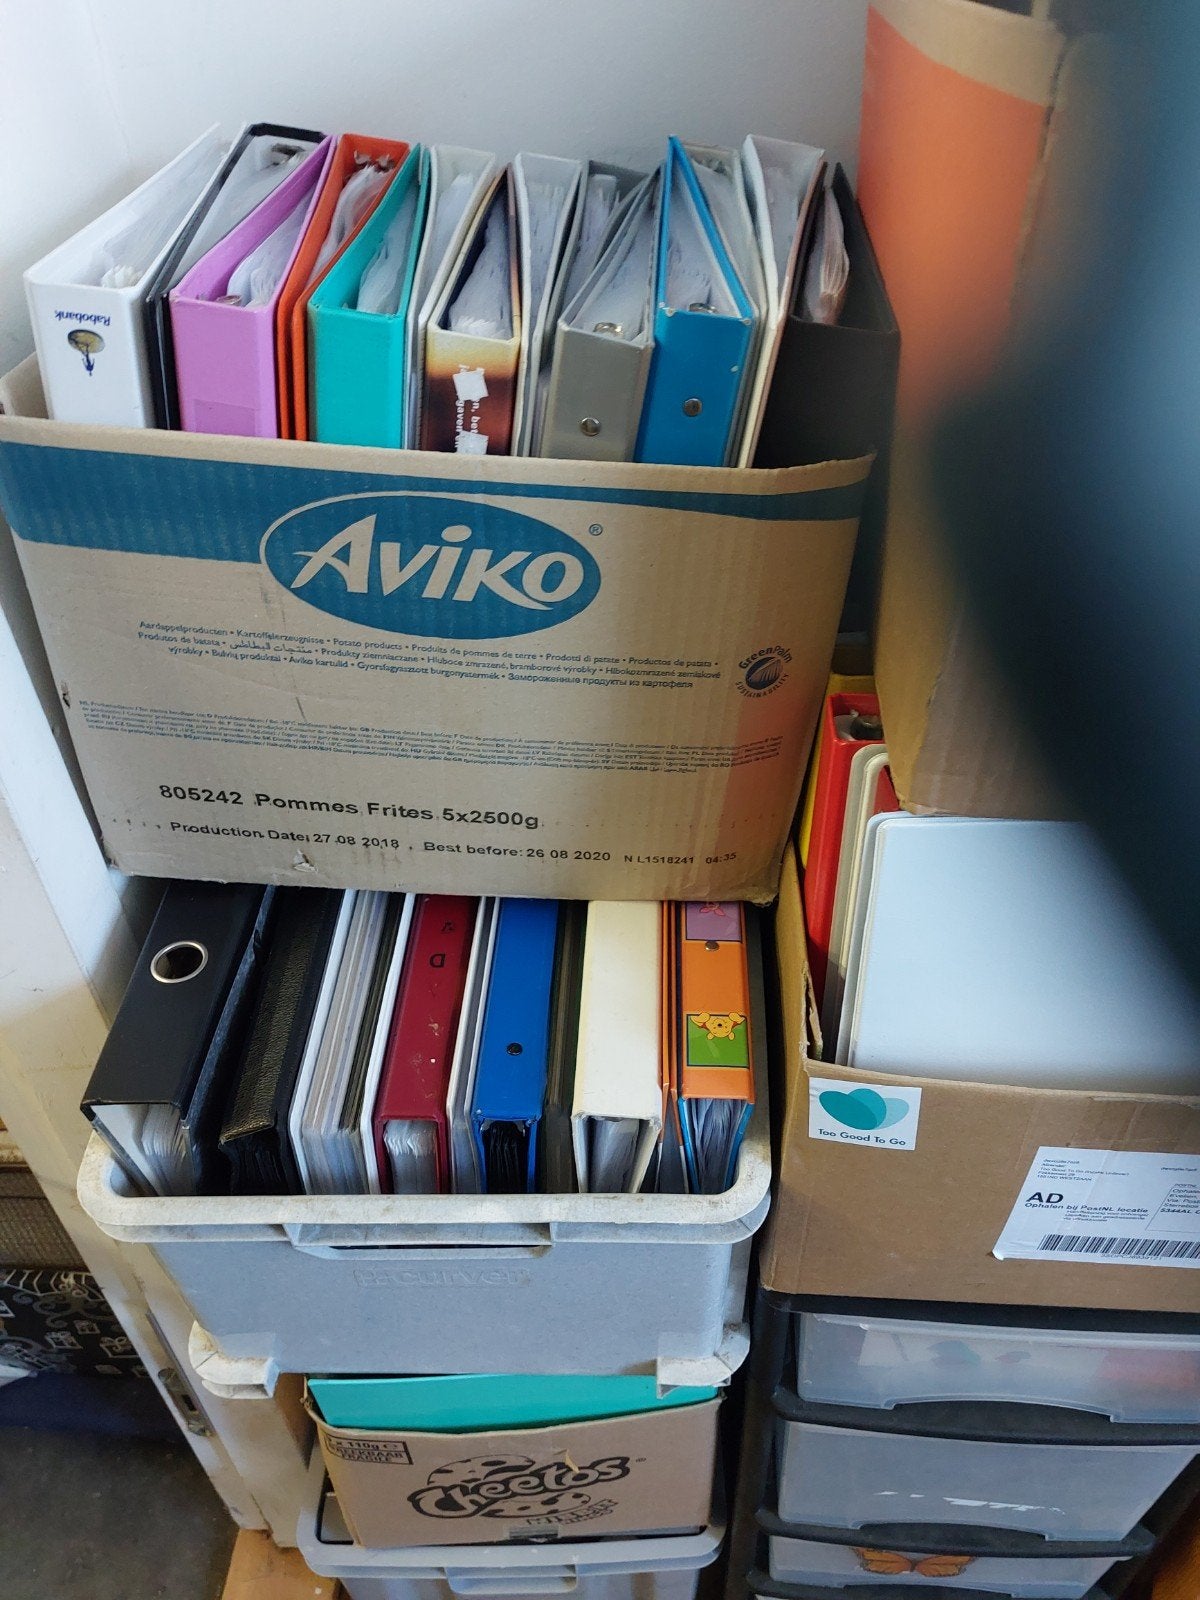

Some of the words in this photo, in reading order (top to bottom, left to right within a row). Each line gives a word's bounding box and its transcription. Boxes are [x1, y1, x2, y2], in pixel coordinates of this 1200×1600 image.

[55, 309, 111, 327] Rabobank
[139, 620, 228, 636] Aardappelproducten
[236, 629, 325, 644] Kartoffelerzeugnisse
[333, 637, 362, 647] Potato
[364, 641, 403, 650] products
[411, 643, 448, 654] Produits
[450, 647, 461, 655] de
[501, 651, 513, 659] de
[515, 652, 537, 660] terre
[583, 654, 591, 662] di
[628, 657, 671, 666] Productos
[180, 636, 192, 644] de
[321, 647, 360, 660] Produkty
[362, 651, 419, 662] ziemniaczane
[158, 784, 244, 806] 805242
[255, 792, 359, 815] Pommes
[366, 801, 434, 820] Frites
[442, 806, 539, 830] 5x2500g
[169, 820, 265, 840] Production
[423, 840, 461, 853] Best
[466, 843, 524, 858] before:
[818, 1128, 837, 1137] Too
[840, 1131, 871, 1142] Good
[874, 1135, 886, 1144] To
[889, 1138, 906, 1146] Go
[1026, 1191, 1064, 1204] AD
[1117, 1206, 1149, 1214] locatie
